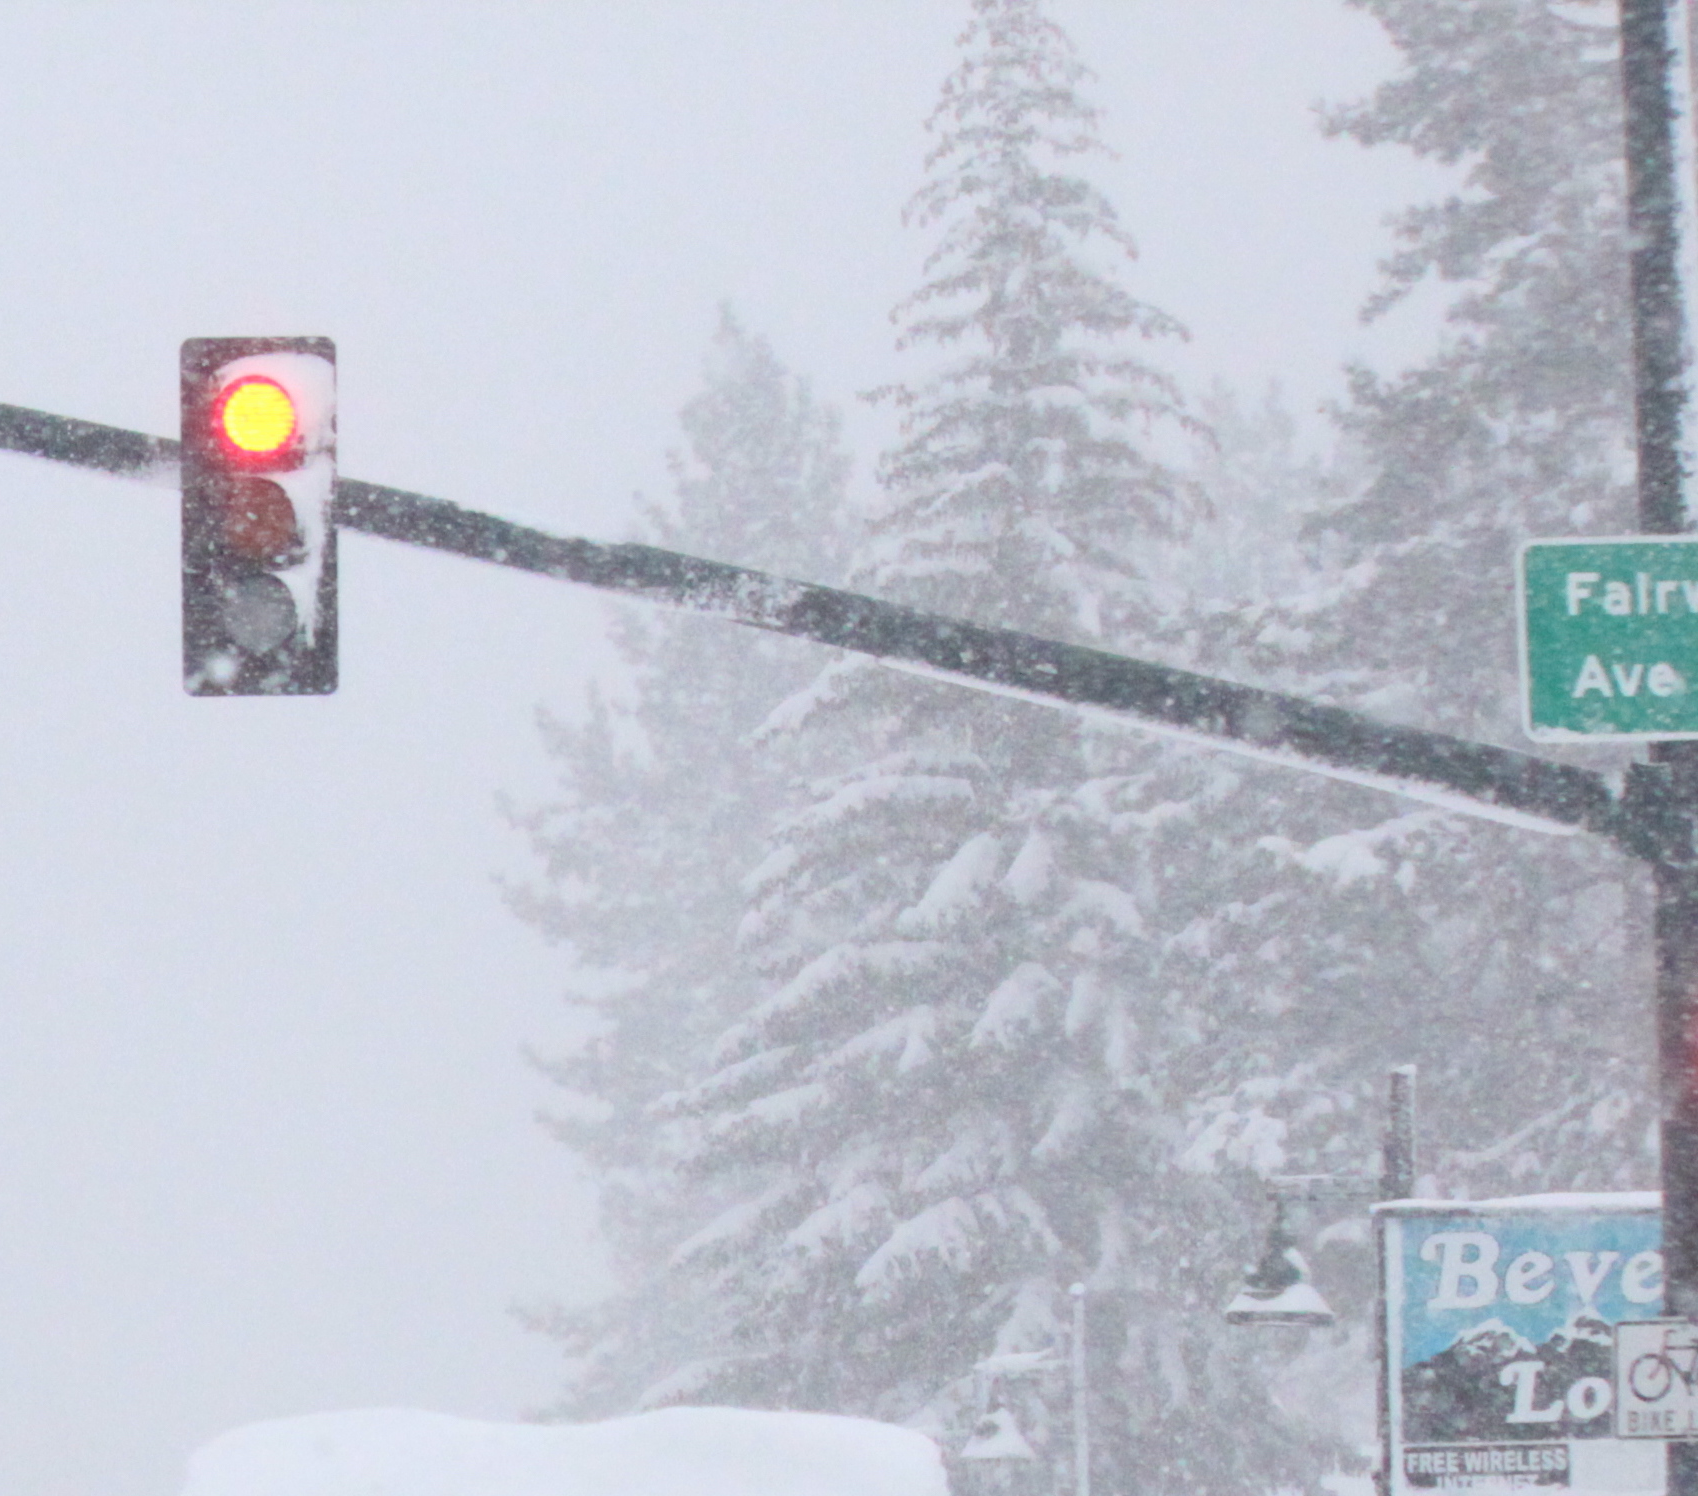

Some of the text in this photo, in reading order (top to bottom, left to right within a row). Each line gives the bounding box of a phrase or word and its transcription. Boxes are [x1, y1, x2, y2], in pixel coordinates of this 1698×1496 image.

[1571, 653, 1686, 698] Ave
[1627, 1410, 1675, 1432] BIKE
[1406, 1449, 1568, 1474] FREE WIRELESS
